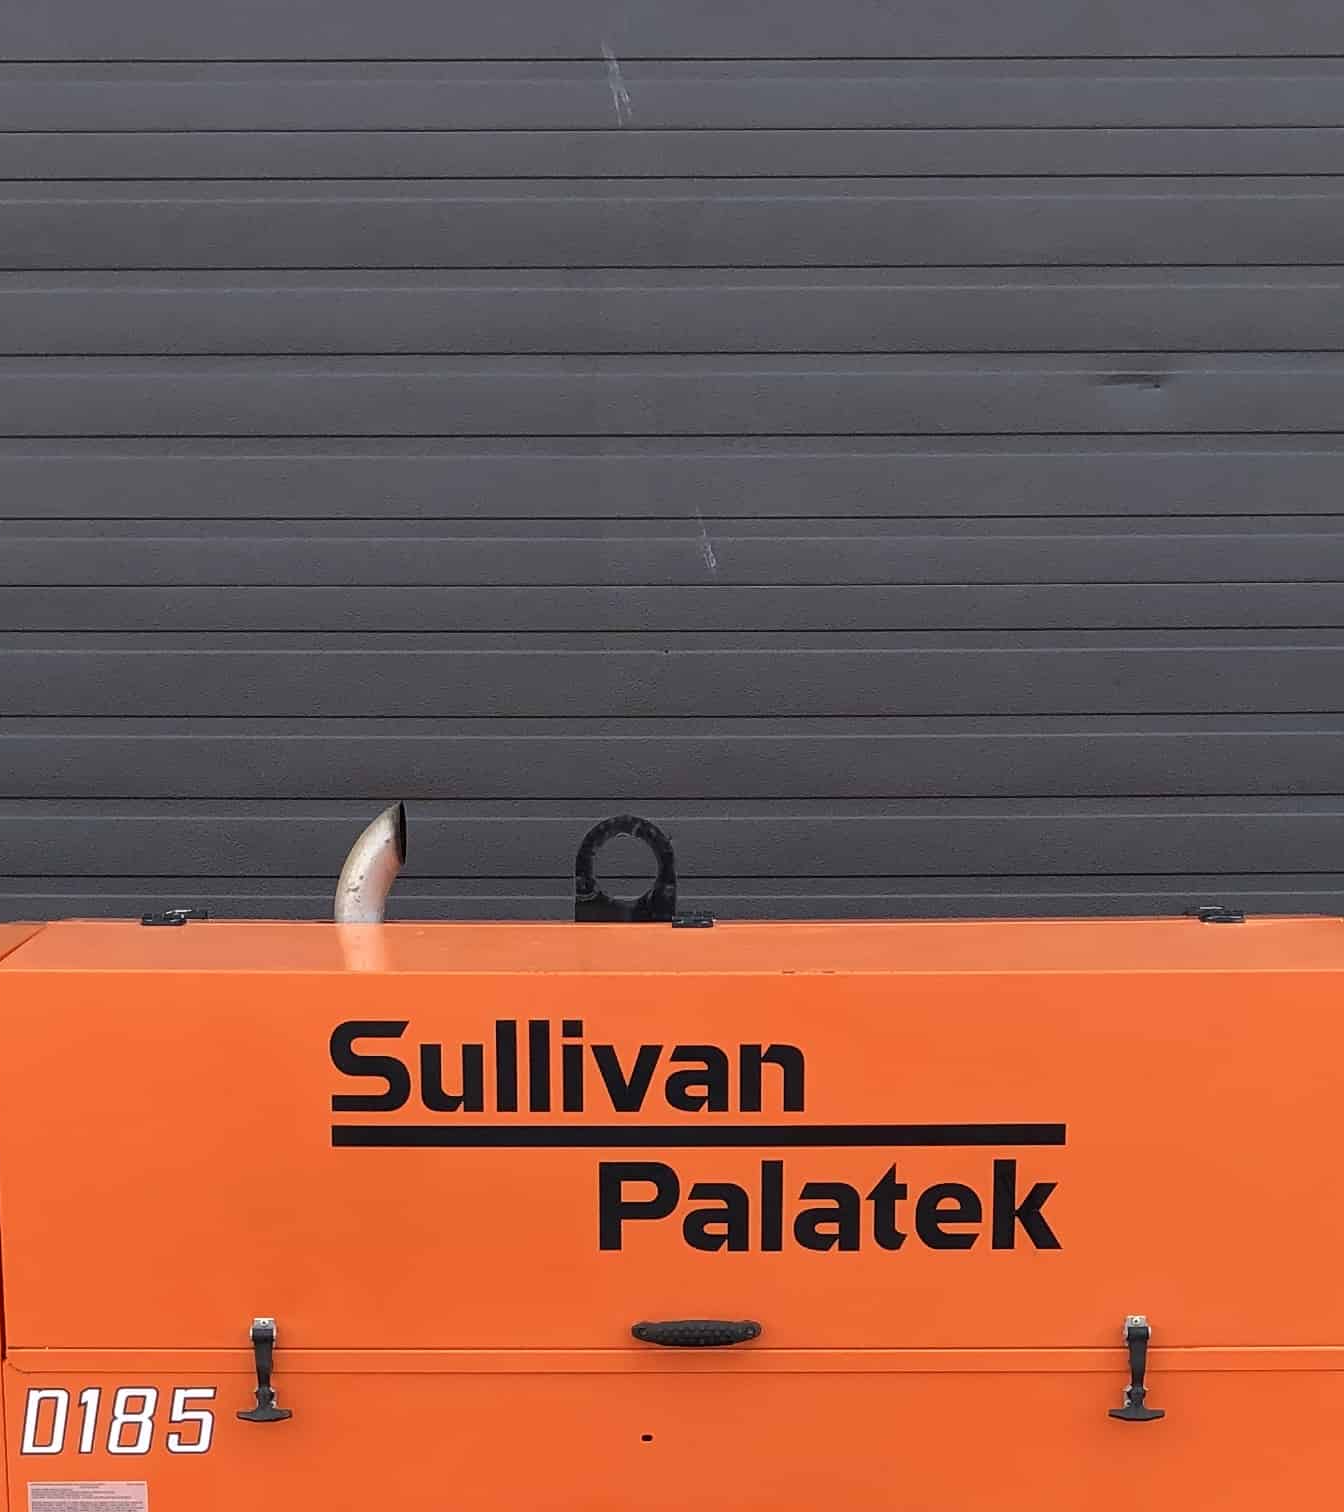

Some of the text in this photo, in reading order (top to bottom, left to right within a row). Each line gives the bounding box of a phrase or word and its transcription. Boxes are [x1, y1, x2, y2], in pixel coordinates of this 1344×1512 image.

[330, 1019, 804, 1113] Sullivan
[599, 1159, 1061, 1252] Palatek
[20, 1387, 217, 1455] D185
